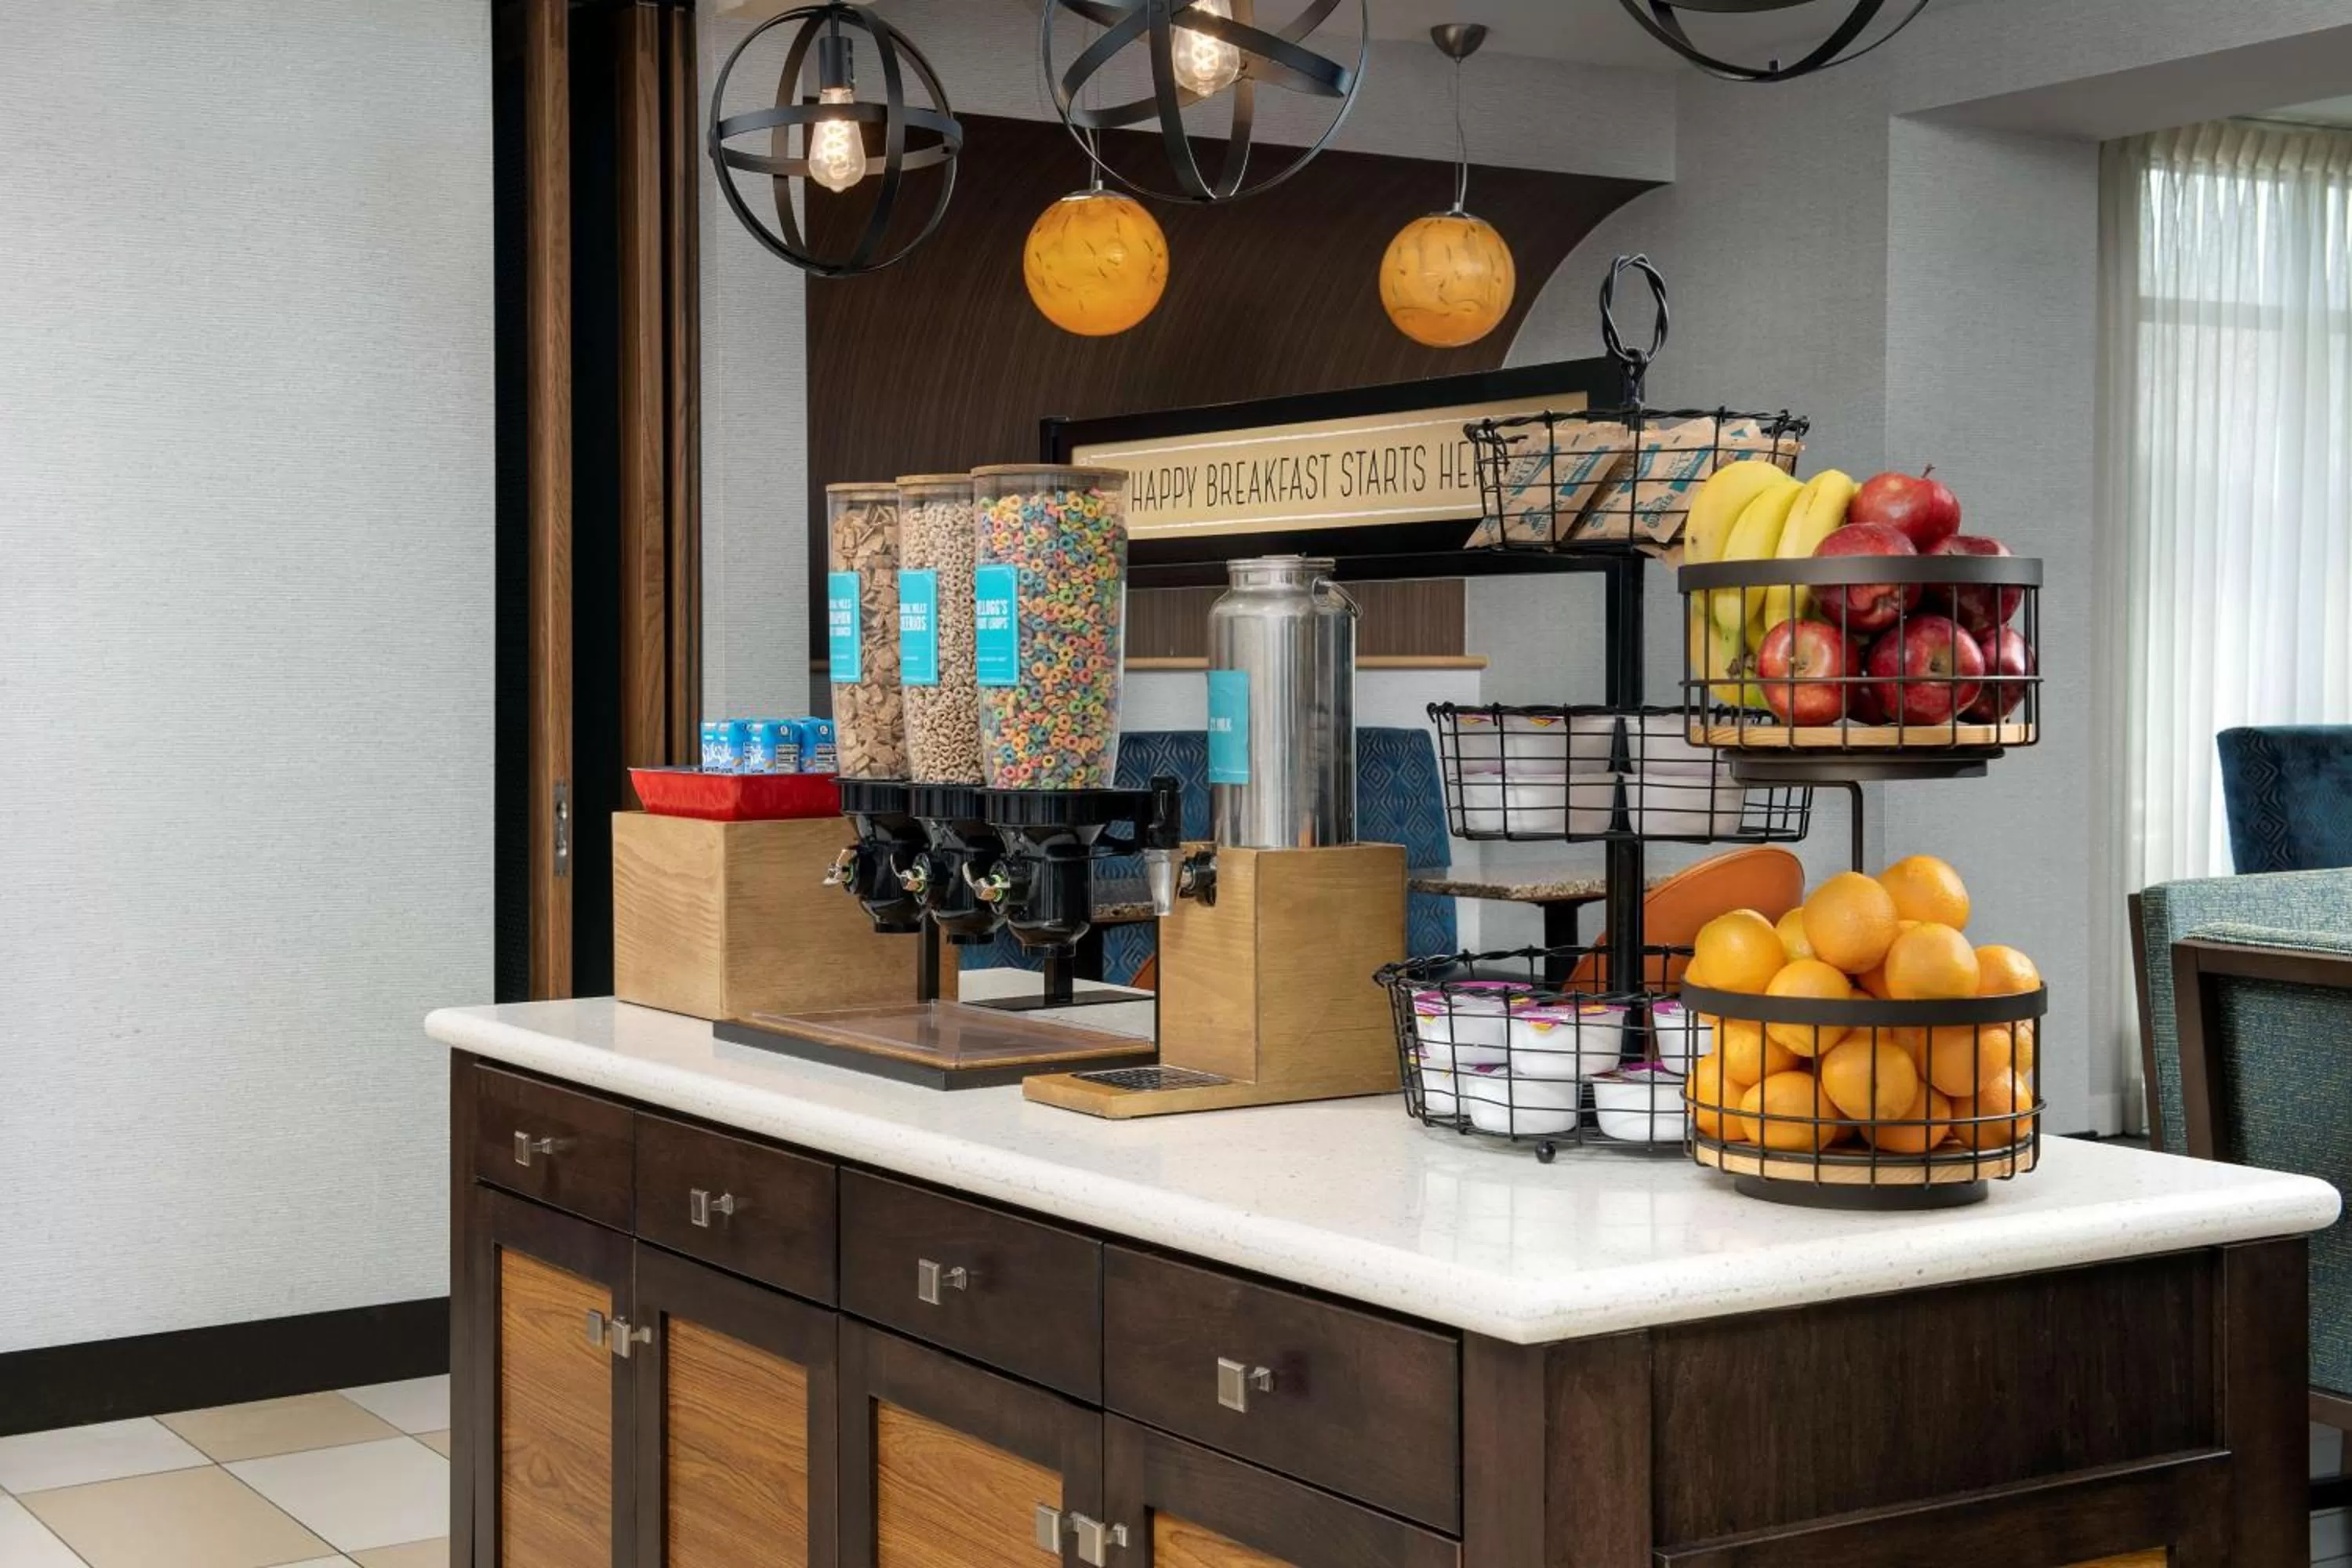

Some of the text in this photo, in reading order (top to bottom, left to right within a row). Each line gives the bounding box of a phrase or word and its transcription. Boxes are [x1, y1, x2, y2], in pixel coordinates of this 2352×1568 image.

[1131, 465, 1197, 513] HAPPY
[1206, 453, 1331, 507] BREAKFAST
[1340, 444, 1426, 498] STARTS
[1439, 440, 1502, 490] HER
